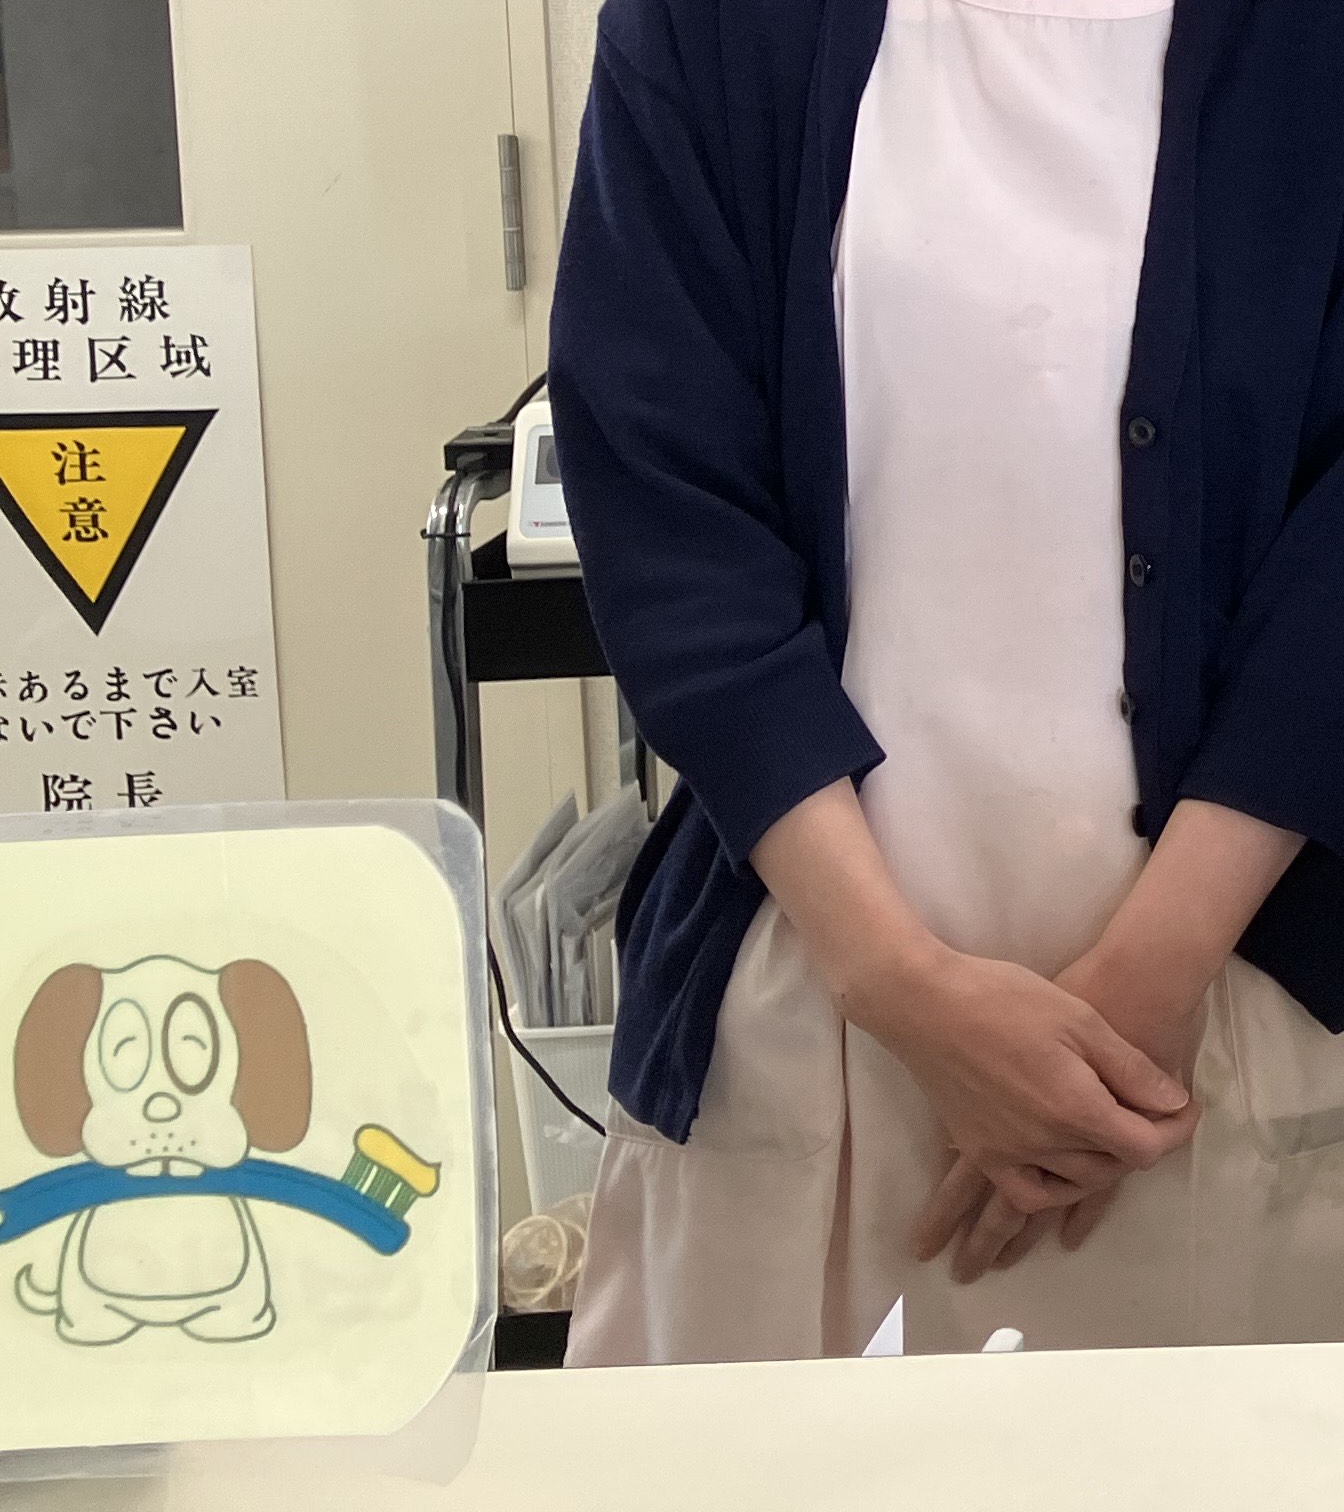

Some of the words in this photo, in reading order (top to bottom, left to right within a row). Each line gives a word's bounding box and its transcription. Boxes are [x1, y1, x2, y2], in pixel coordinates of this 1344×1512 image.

[12, 333, 212, 384] 理区域
[51, 439, 112, 545] 注意
[0, 665, 260, 703] あるまで入室
[42, 770, 164, 812] 院長
